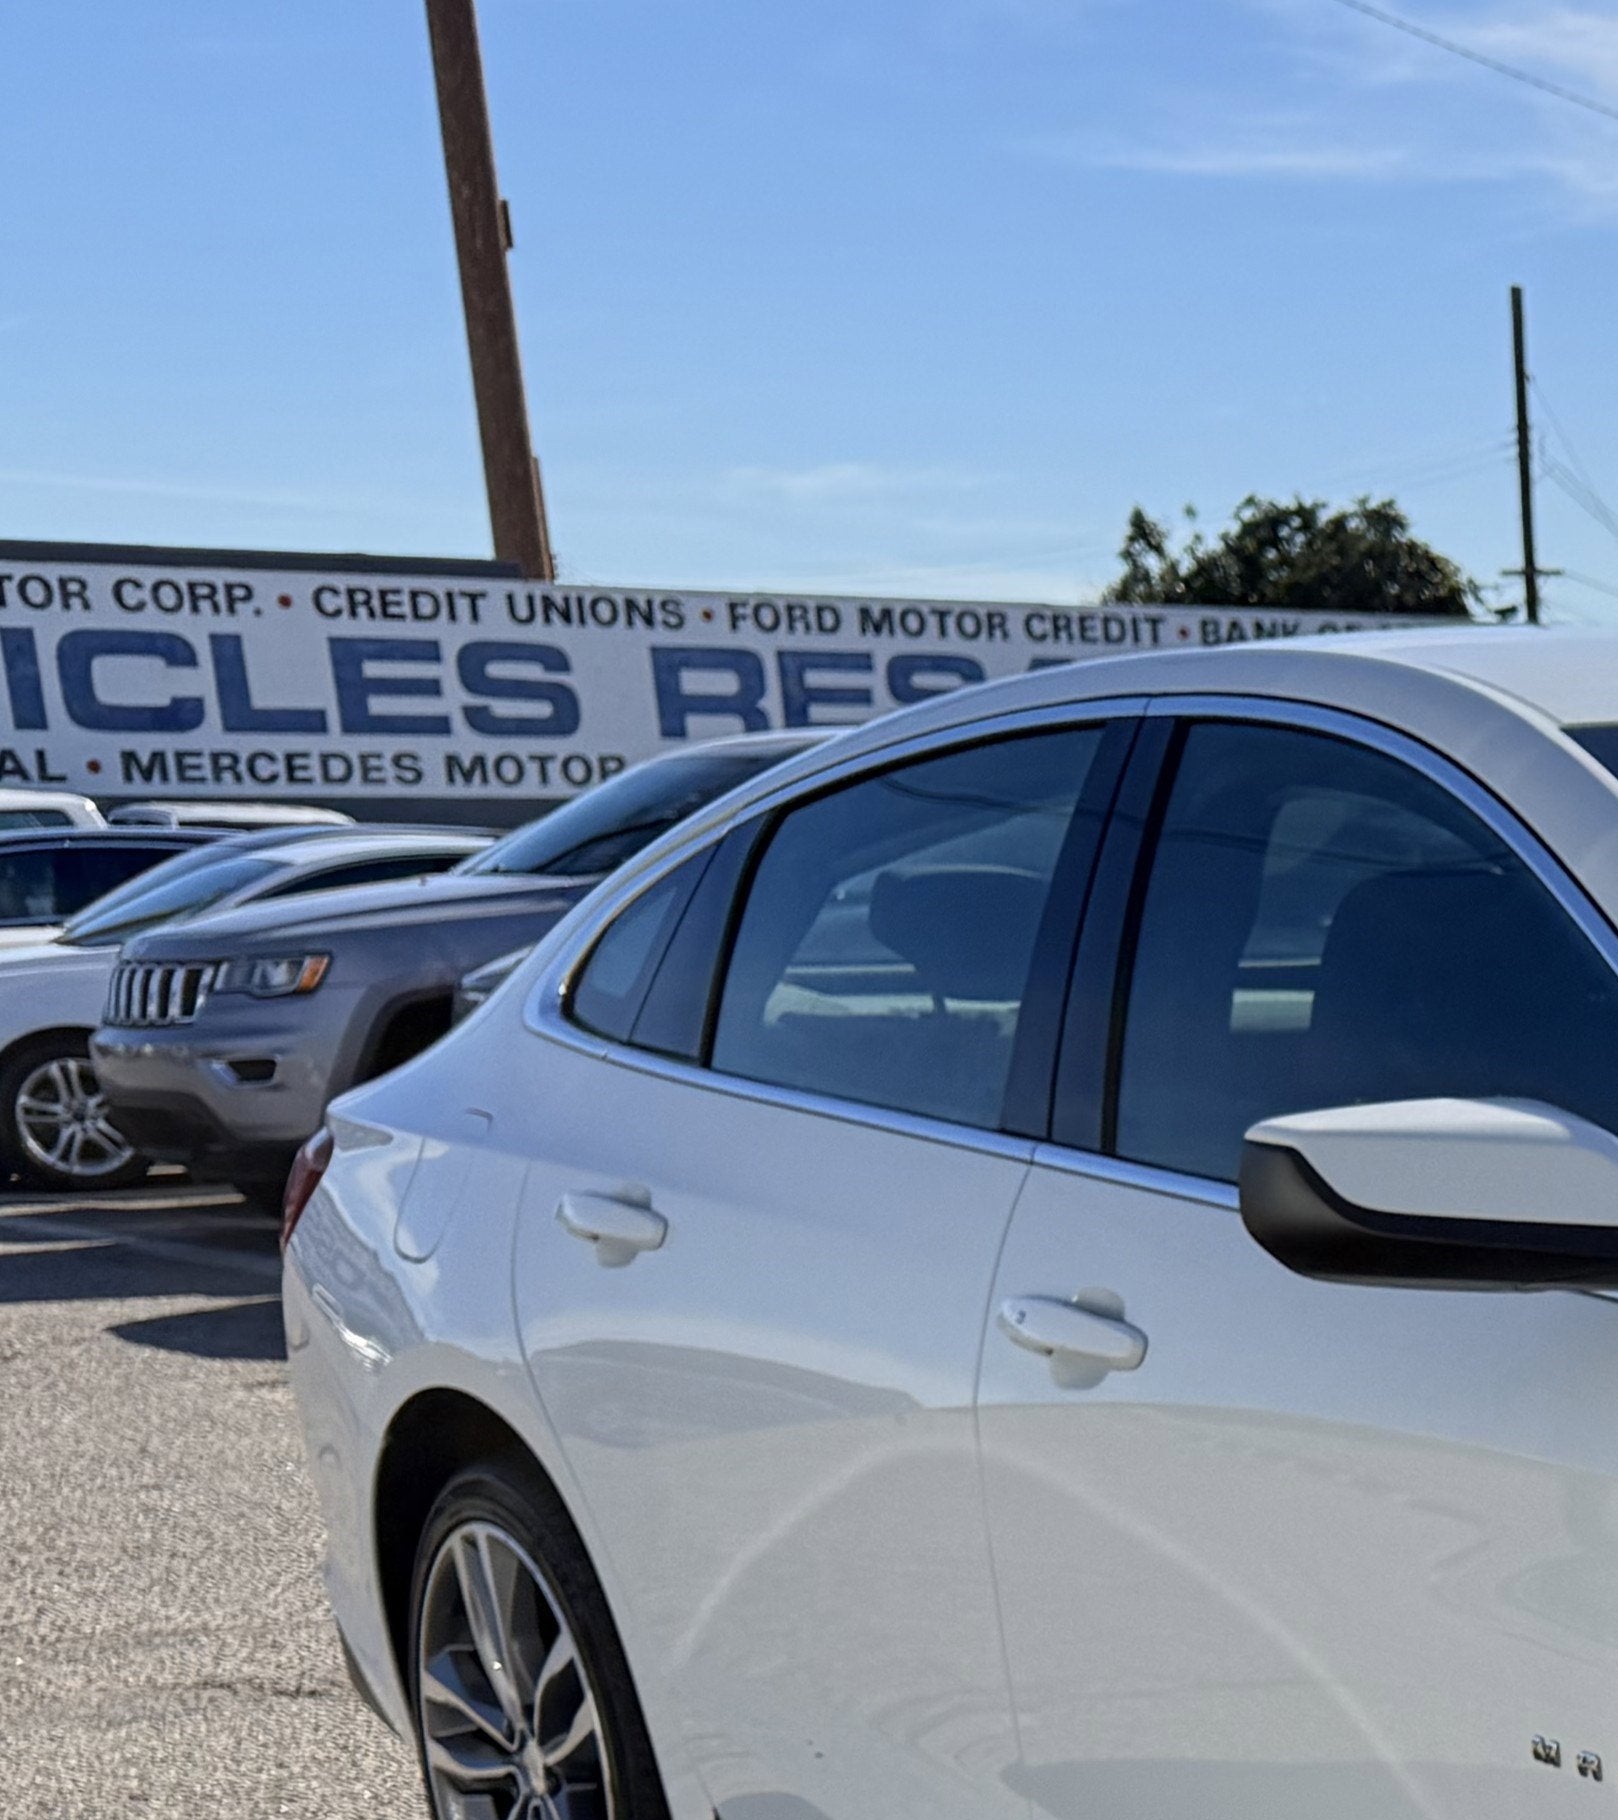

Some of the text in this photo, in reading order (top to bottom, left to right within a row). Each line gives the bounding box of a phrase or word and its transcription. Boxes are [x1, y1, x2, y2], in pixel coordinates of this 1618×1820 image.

[111, 577, 263, 618] CORP.
[312, 585, 487, 625] CREDIT
[506, 591, 686, 630] UNIONS
[728, 602, 842, 634] FORD
[859, 607, 1010, 642] MOTOR
[1024, 612, 1167, 645] CREDIT
[0, 627, 582, 738] ICLES
[120, 749, 424, 785] MERCEDES
